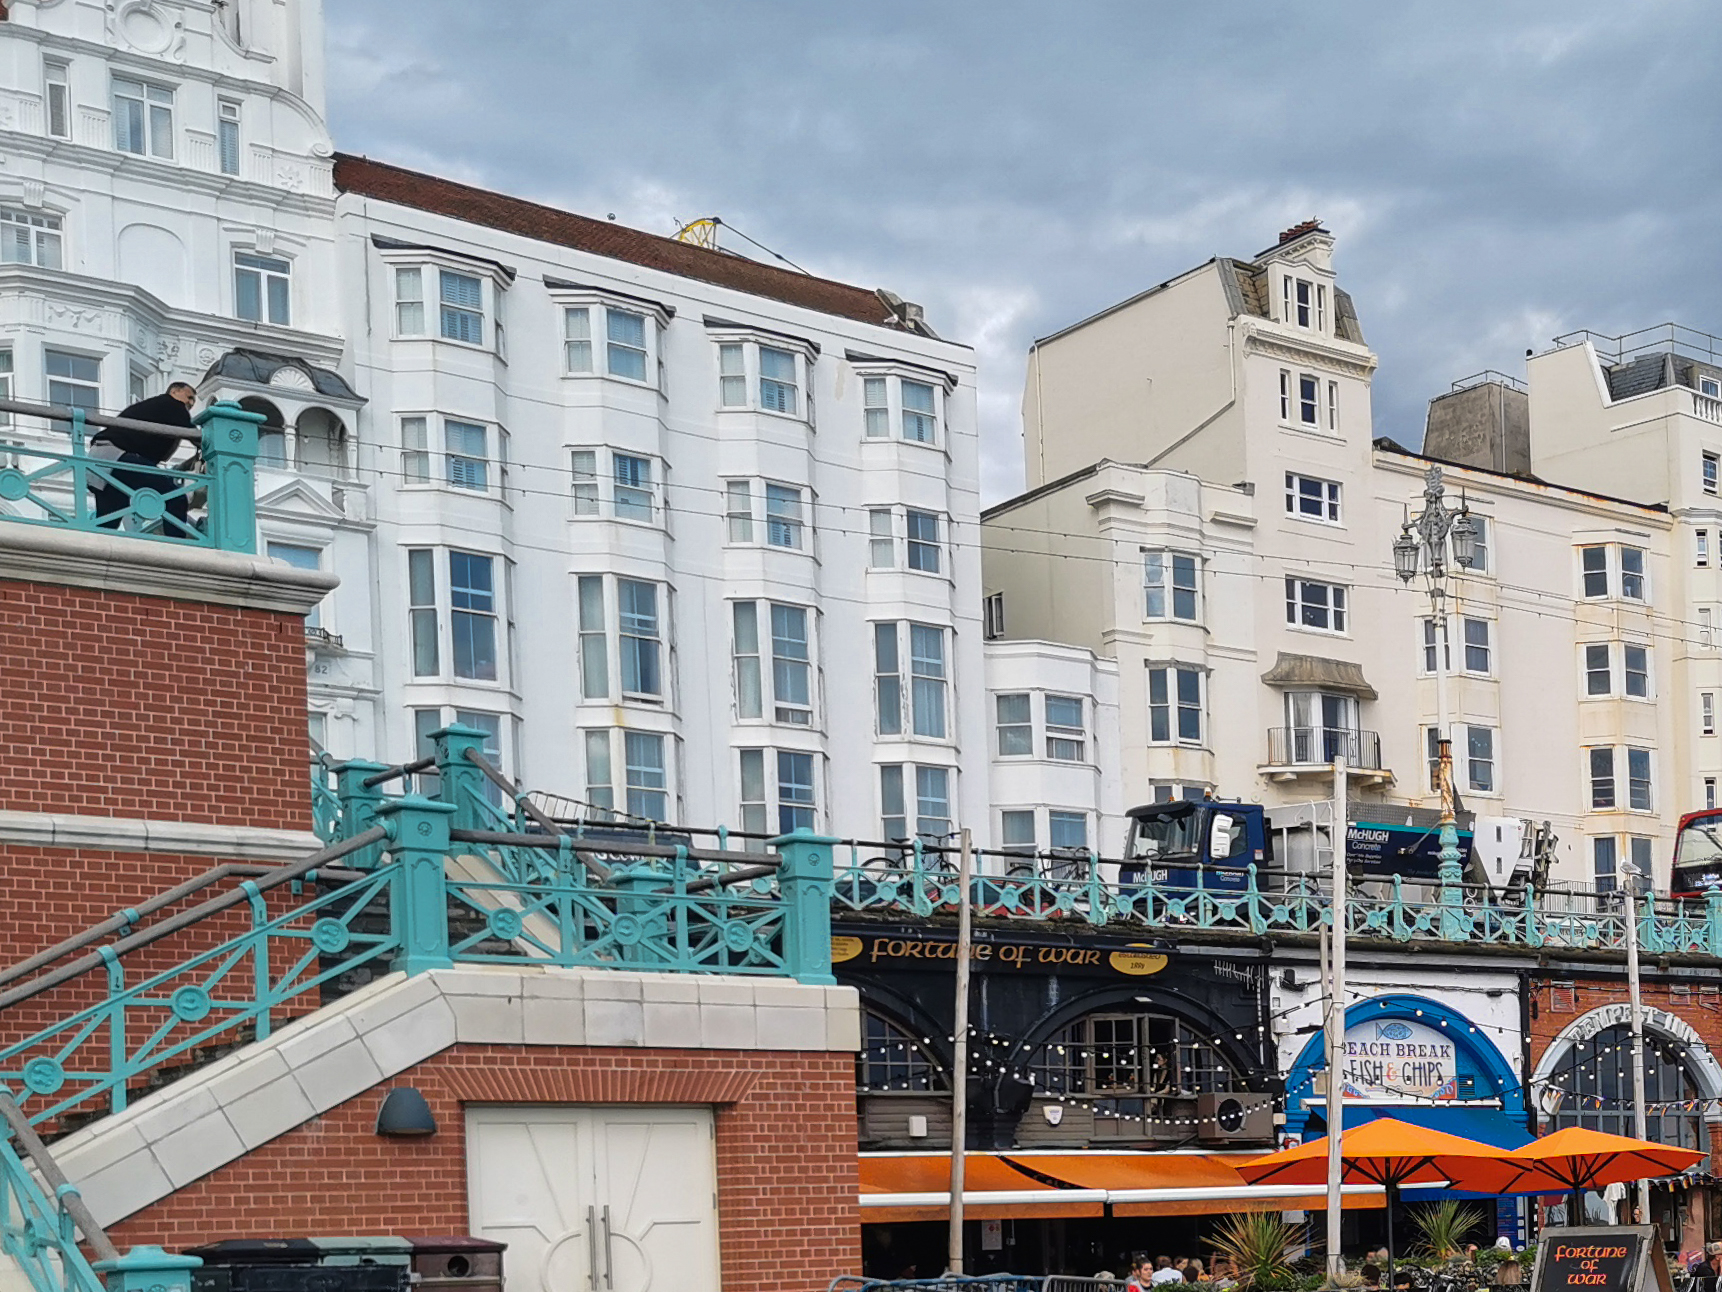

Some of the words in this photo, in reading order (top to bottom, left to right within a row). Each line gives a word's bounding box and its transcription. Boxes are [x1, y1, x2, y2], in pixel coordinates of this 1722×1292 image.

[1347, 828, 1389, 842] McHUGH
[1567, 1005, 1658, 1045] TEMPET
[1396, 1043, 1451, 1058] BREAK
[1350, 1060, 1383, 1086] FISH
[1386, 1062, 1400, 1081] &
[1402, 1061, 1444, 1086] CHIPS
